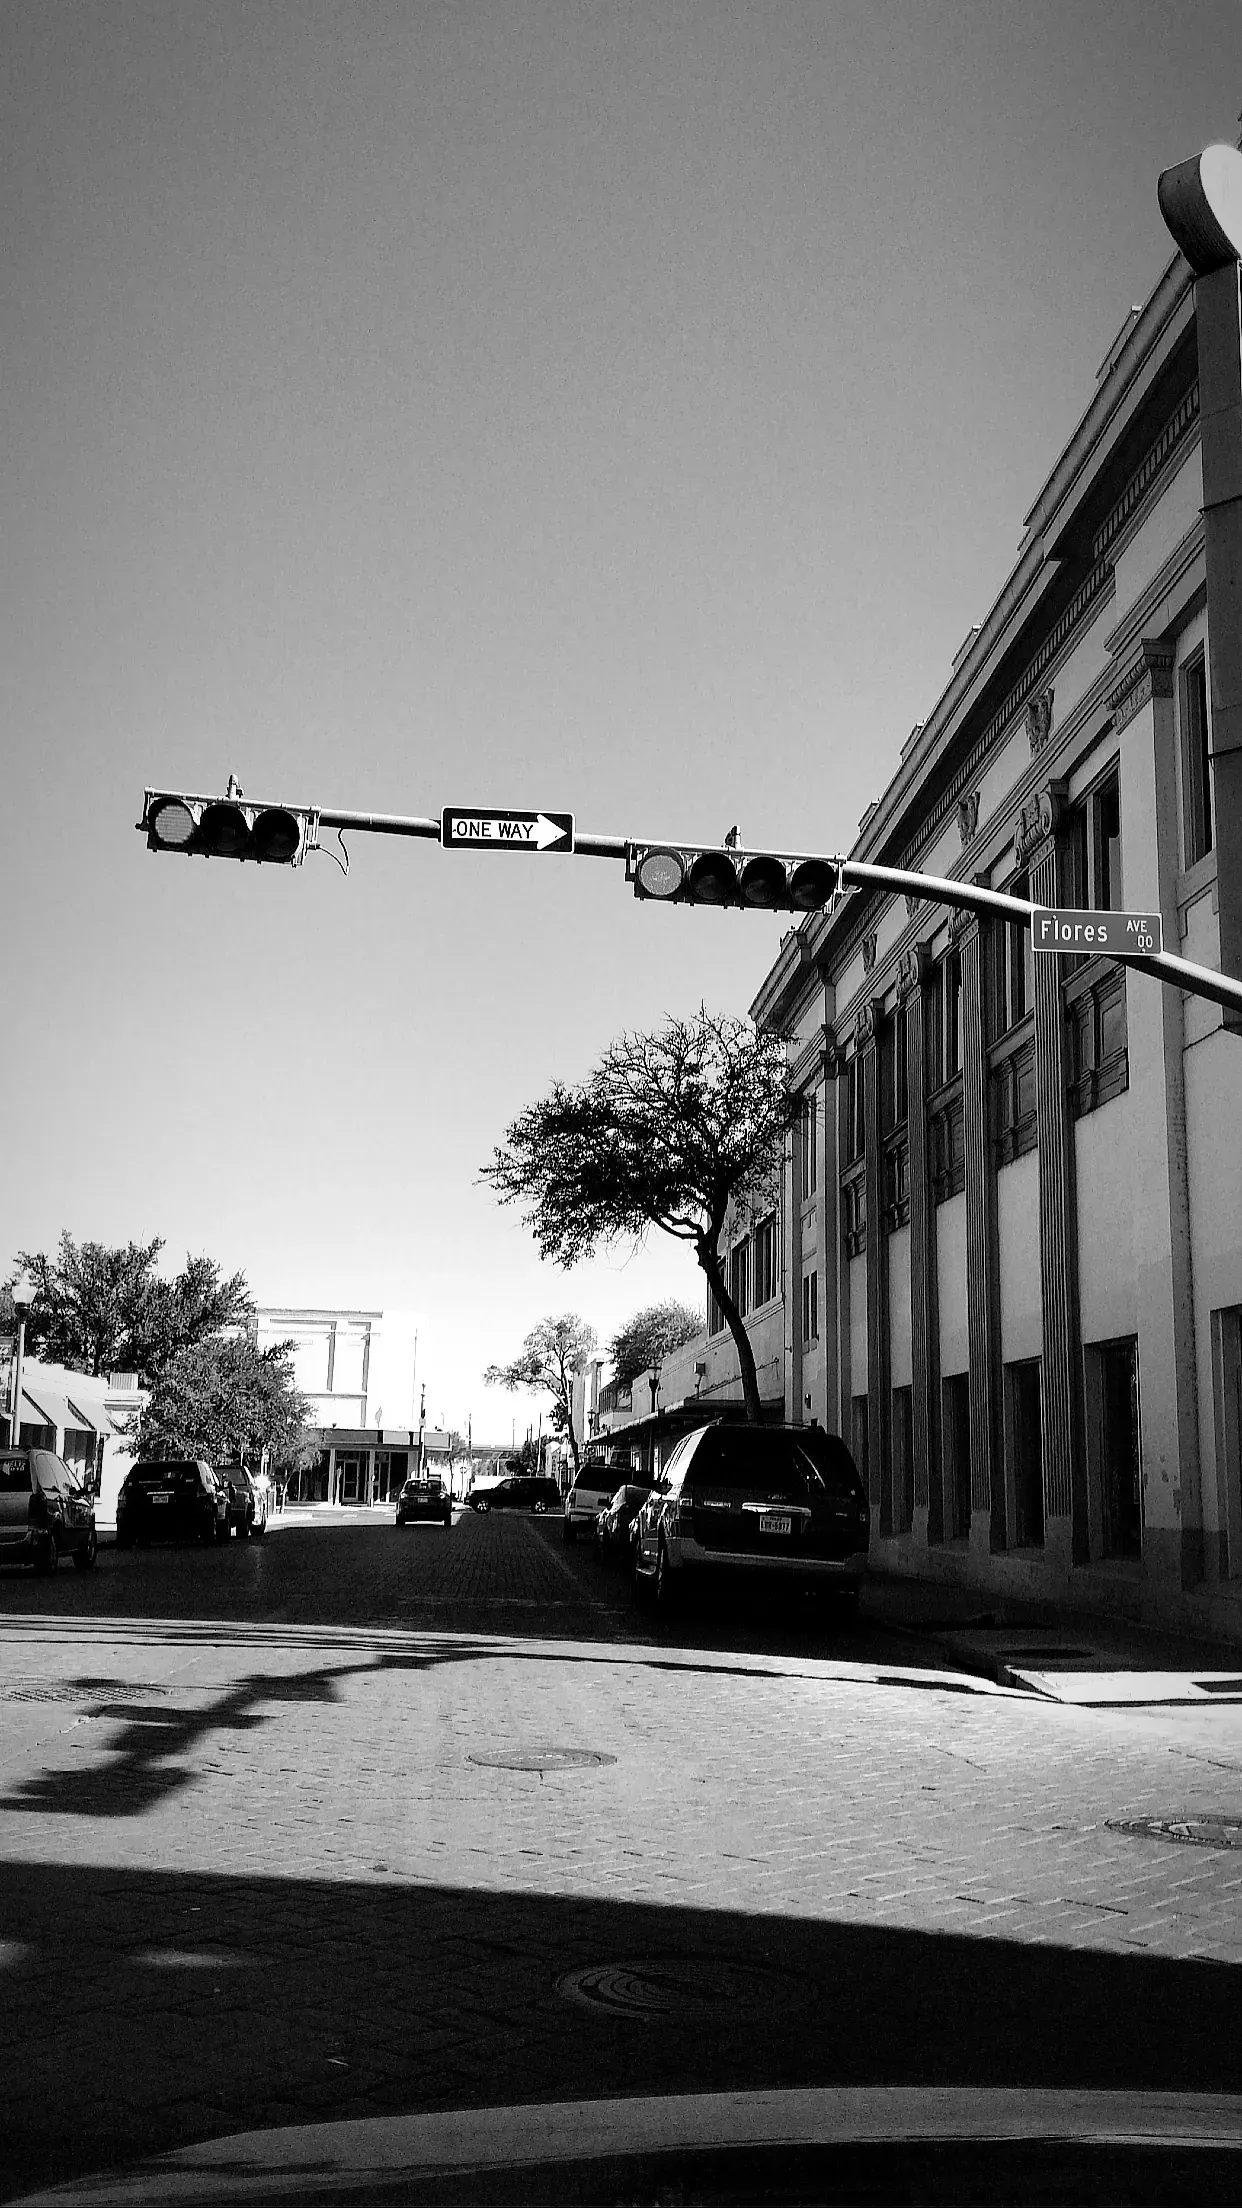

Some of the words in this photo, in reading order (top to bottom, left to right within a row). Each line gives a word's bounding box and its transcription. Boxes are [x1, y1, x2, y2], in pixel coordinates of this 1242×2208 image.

[456, 821, 492, 838] ONE
[498, 822, 534, 839] WAY
[1041, 919, 1108, 942] Flores
[1126, 919, 1148, 933] AVE
